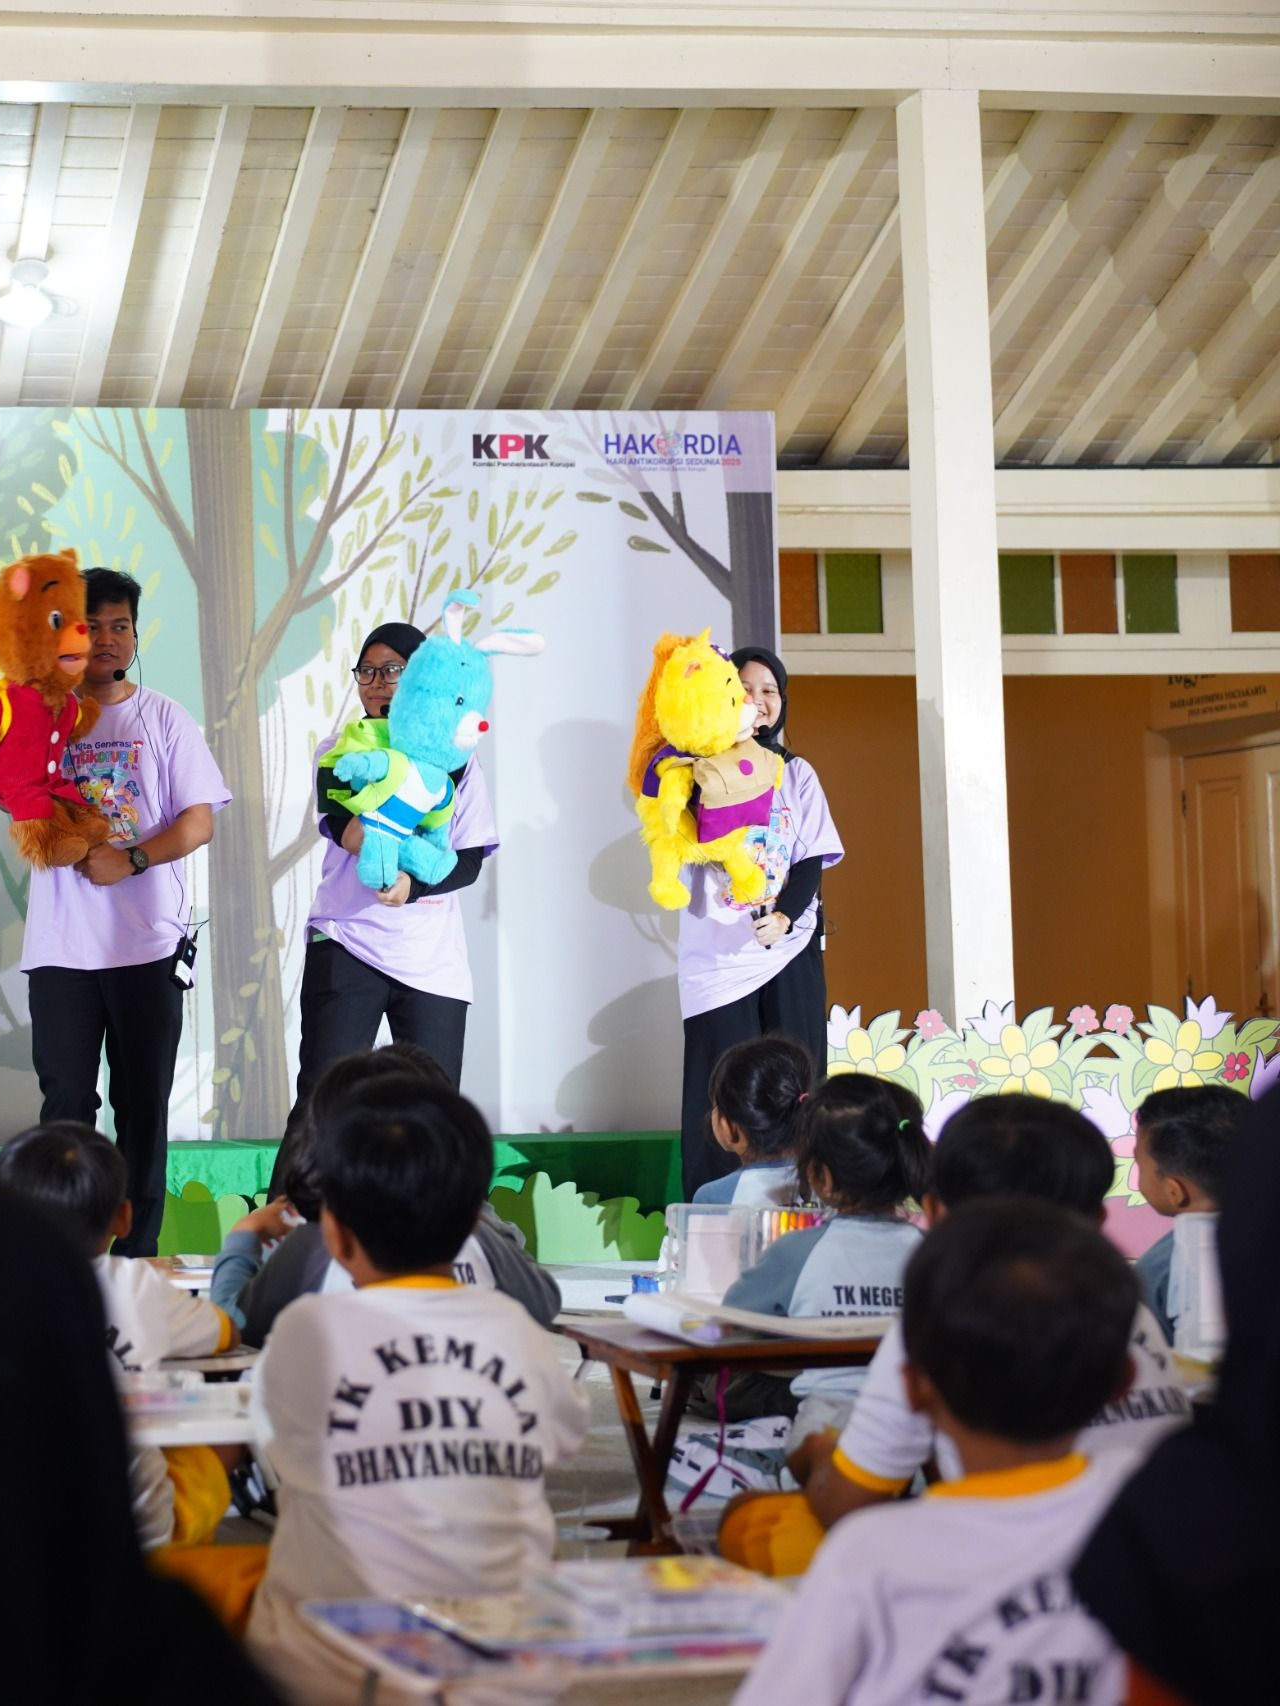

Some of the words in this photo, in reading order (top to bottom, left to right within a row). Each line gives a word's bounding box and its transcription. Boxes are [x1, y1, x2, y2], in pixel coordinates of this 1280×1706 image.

[472, 434, 551, 459] KPK
[75, 743, 92, 751] Kita
[94, 740, 131, 749] Generasi
[63, 749, 139, 769] Antikorupsi
[833, 1285, 856, 1305] TK
[860, 1286, 904, 1307] NEGE
[327, 1373, 374, 1438] TK
[374, 1333, 538, 1436] KEMALA
[398, 1396, 483, 1432] DIY
